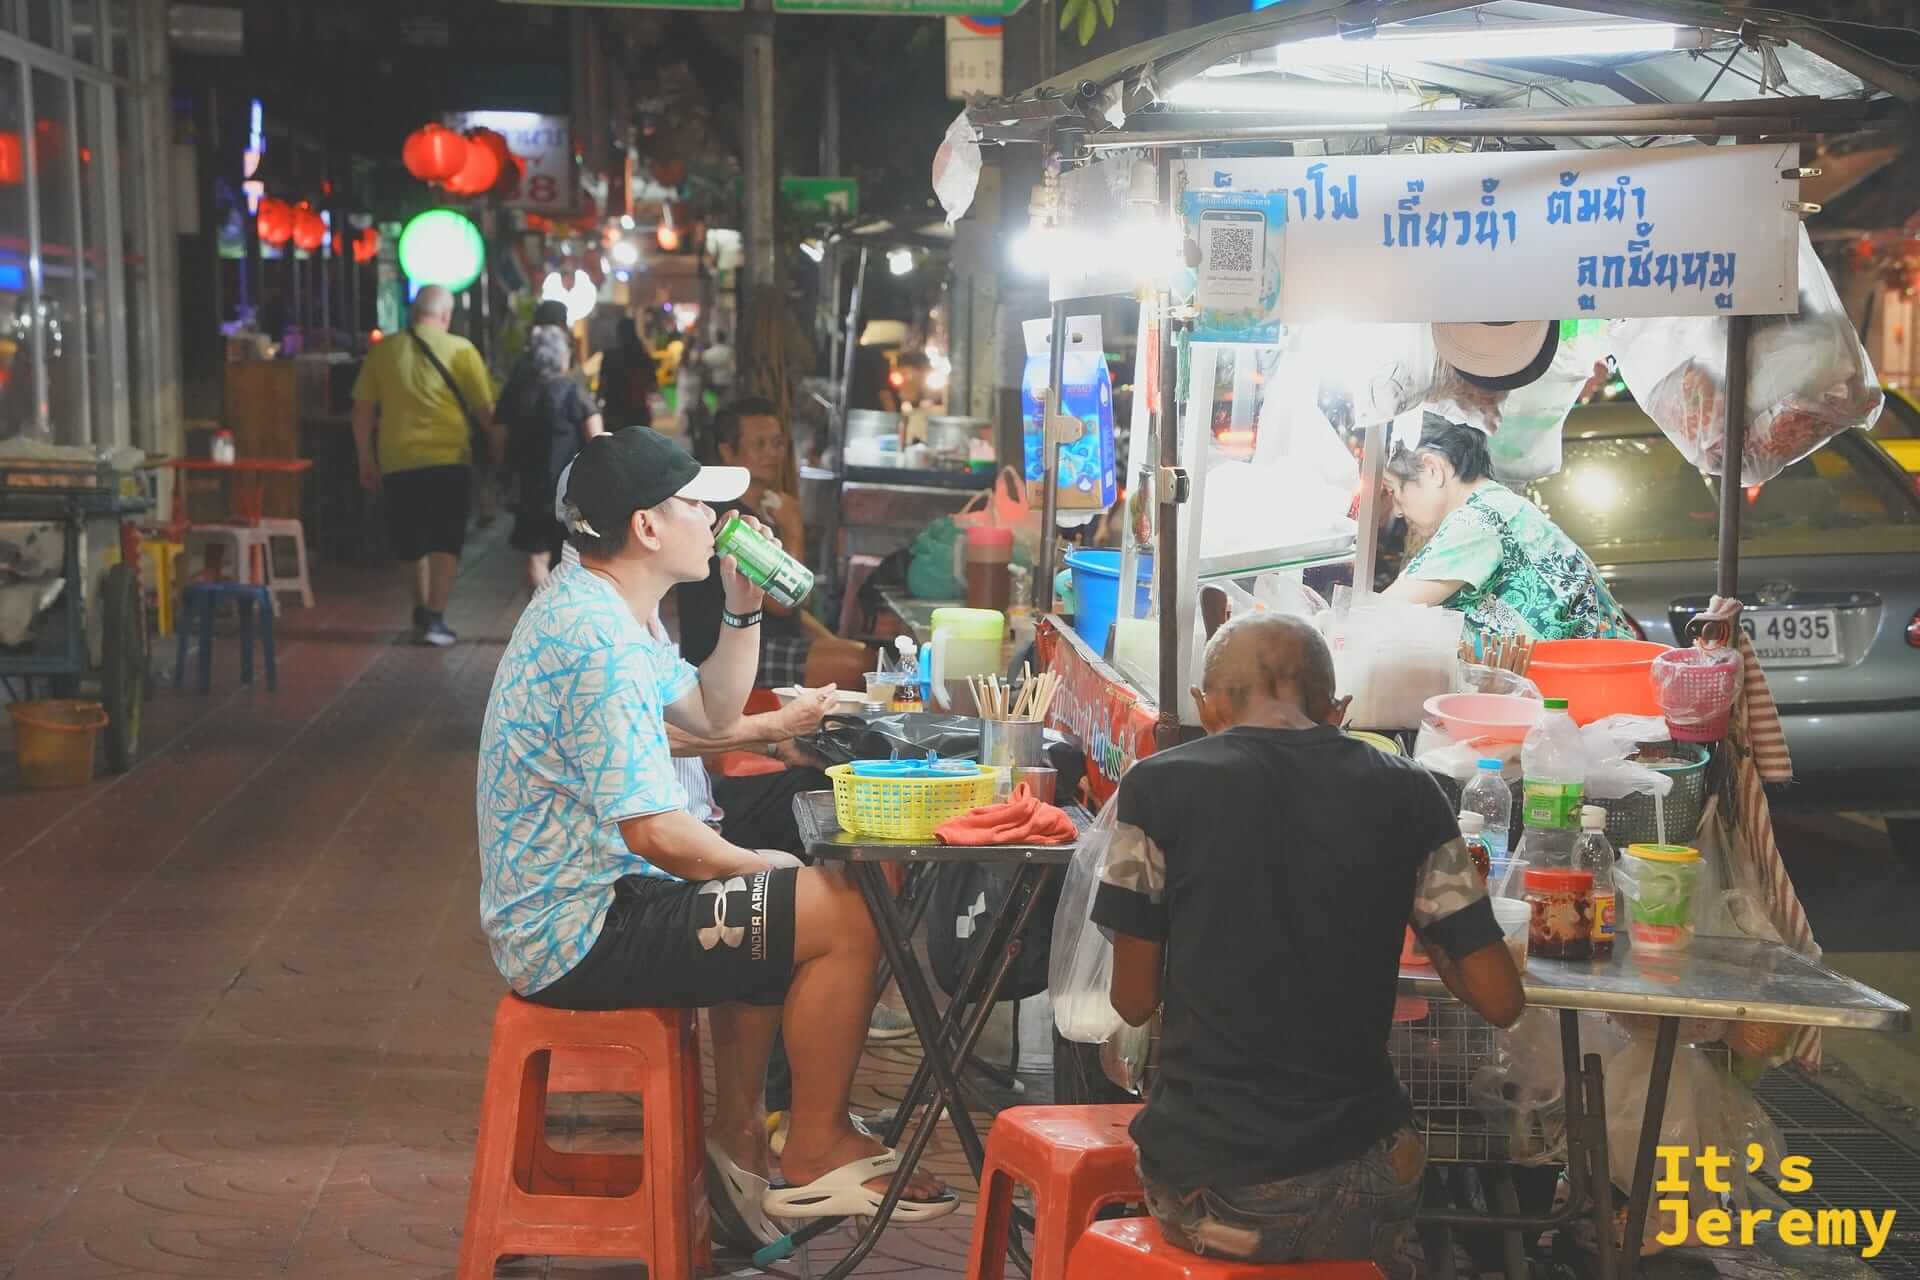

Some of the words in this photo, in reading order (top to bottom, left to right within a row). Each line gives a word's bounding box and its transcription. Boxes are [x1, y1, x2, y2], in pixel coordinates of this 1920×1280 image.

[1383, 178, 1517, 251] เกี๊ยวน้ำ
[1546, 171, 1647, 225] ต้มยำ
[1576, 222, 1737, 311] ลูกชิ้นหมู
[1767, 616, 1830, 640] 4935
[751, 916, 762, 960] UNDER
